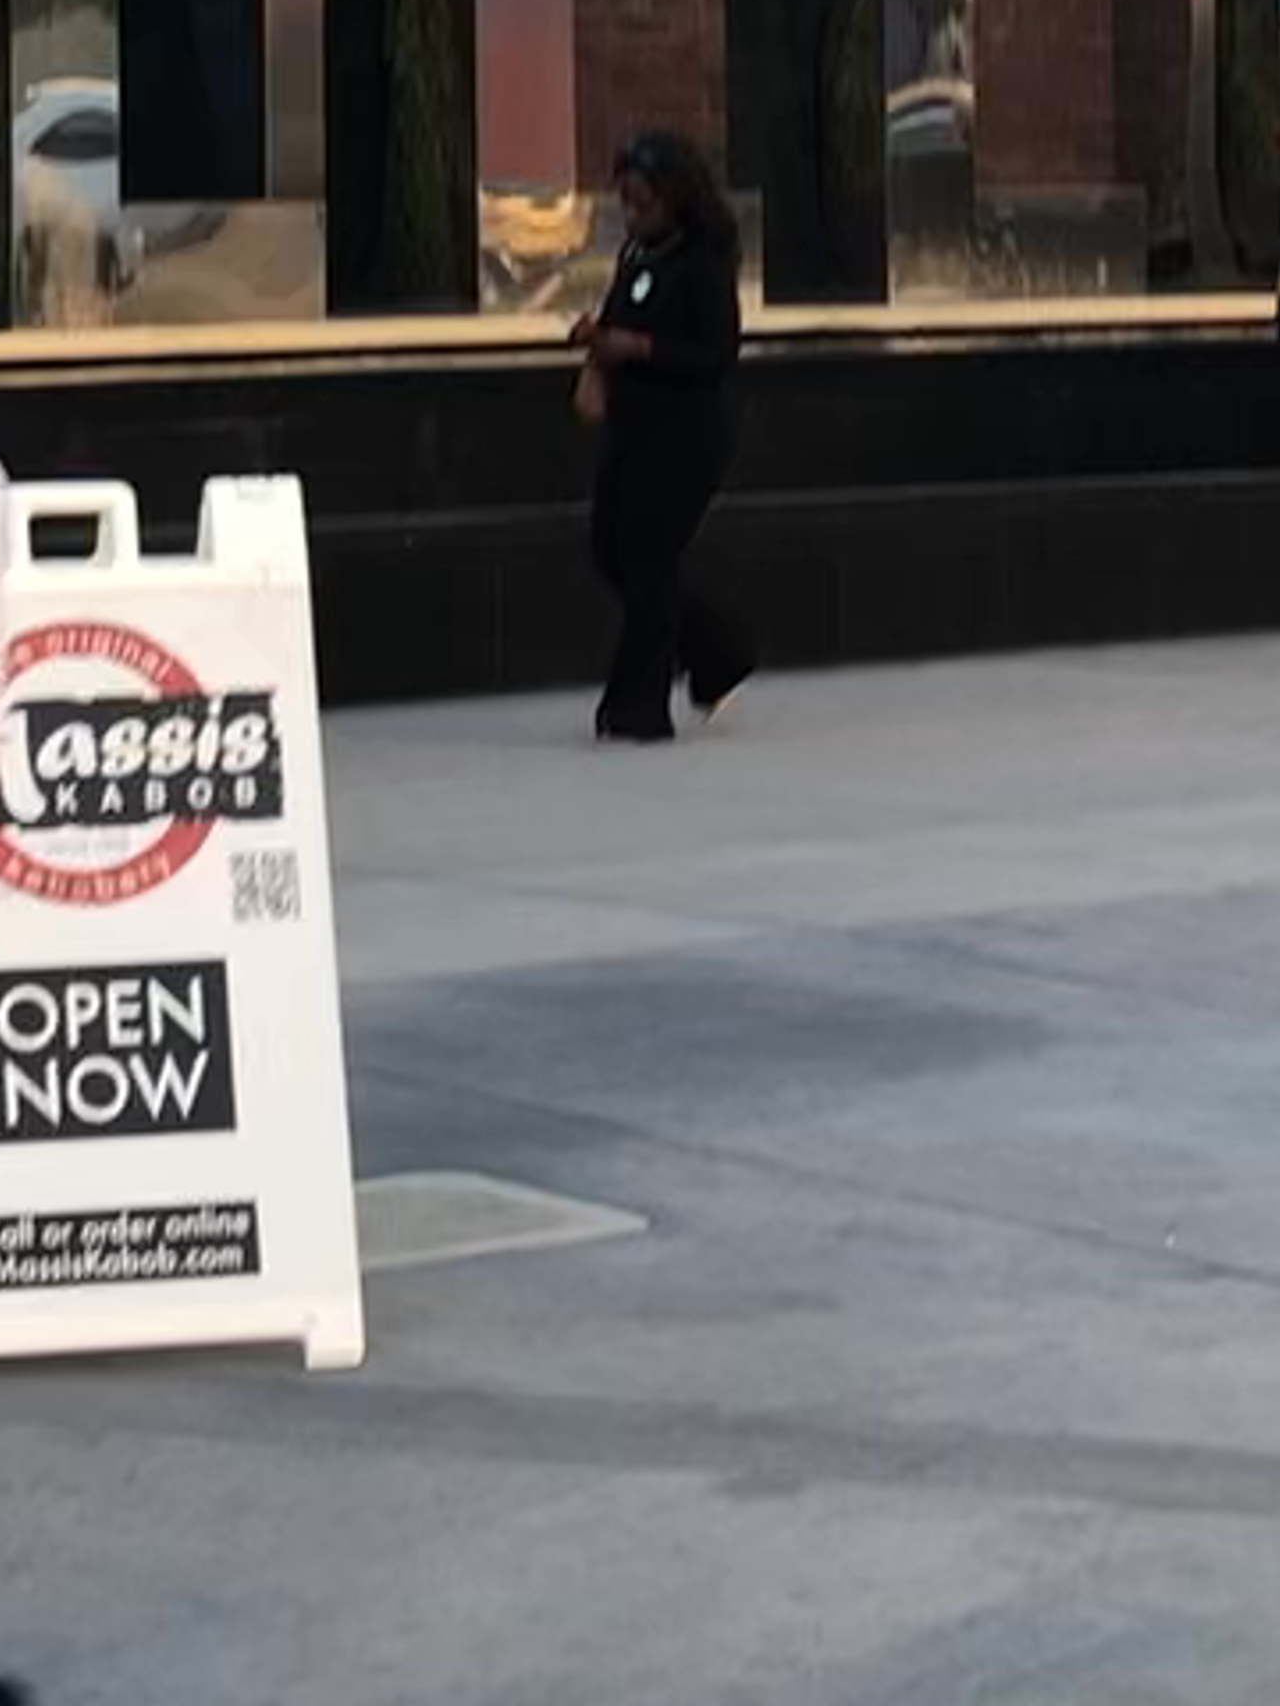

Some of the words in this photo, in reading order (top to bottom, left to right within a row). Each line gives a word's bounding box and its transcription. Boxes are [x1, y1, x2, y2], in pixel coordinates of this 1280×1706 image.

[54, 776, 257, 816] KABOB
[3, 1049, 209, 1129] NOW
[40, 1220, 74, 1250] or
[79, 1208, 156, 1246] order
[164, 1205, 251, 1242] online
